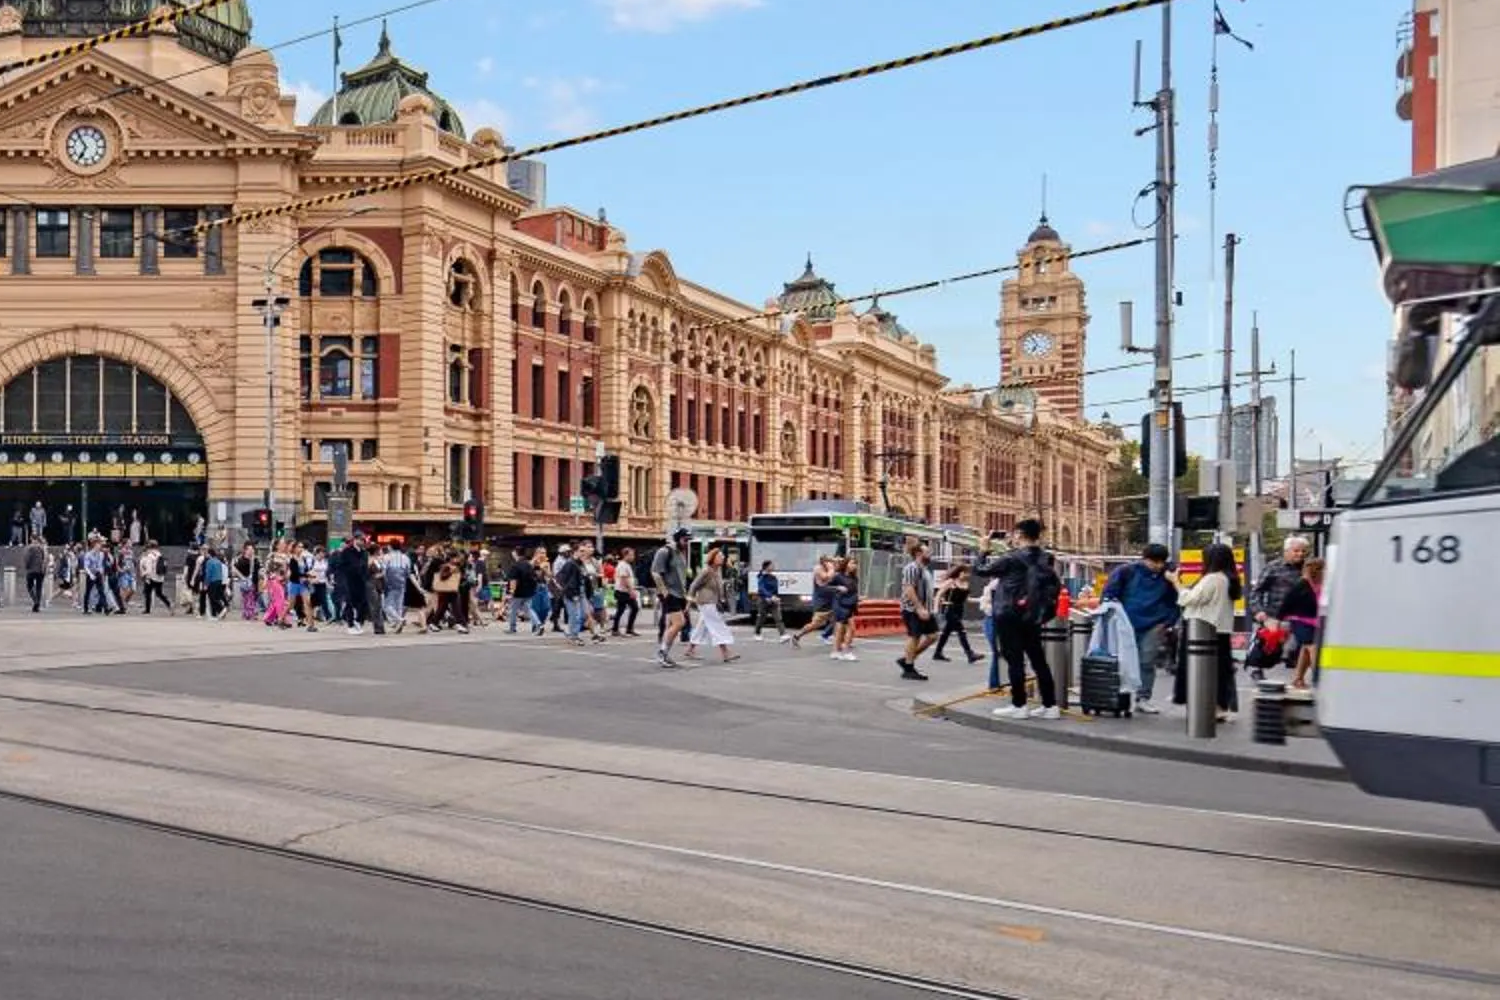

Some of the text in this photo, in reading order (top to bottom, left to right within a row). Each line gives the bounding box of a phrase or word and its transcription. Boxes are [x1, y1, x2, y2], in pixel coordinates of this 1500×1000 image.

[1, 435, 169, 445] FLINDERS STREET STATION
[1390, 535, 1461, 564] 168
